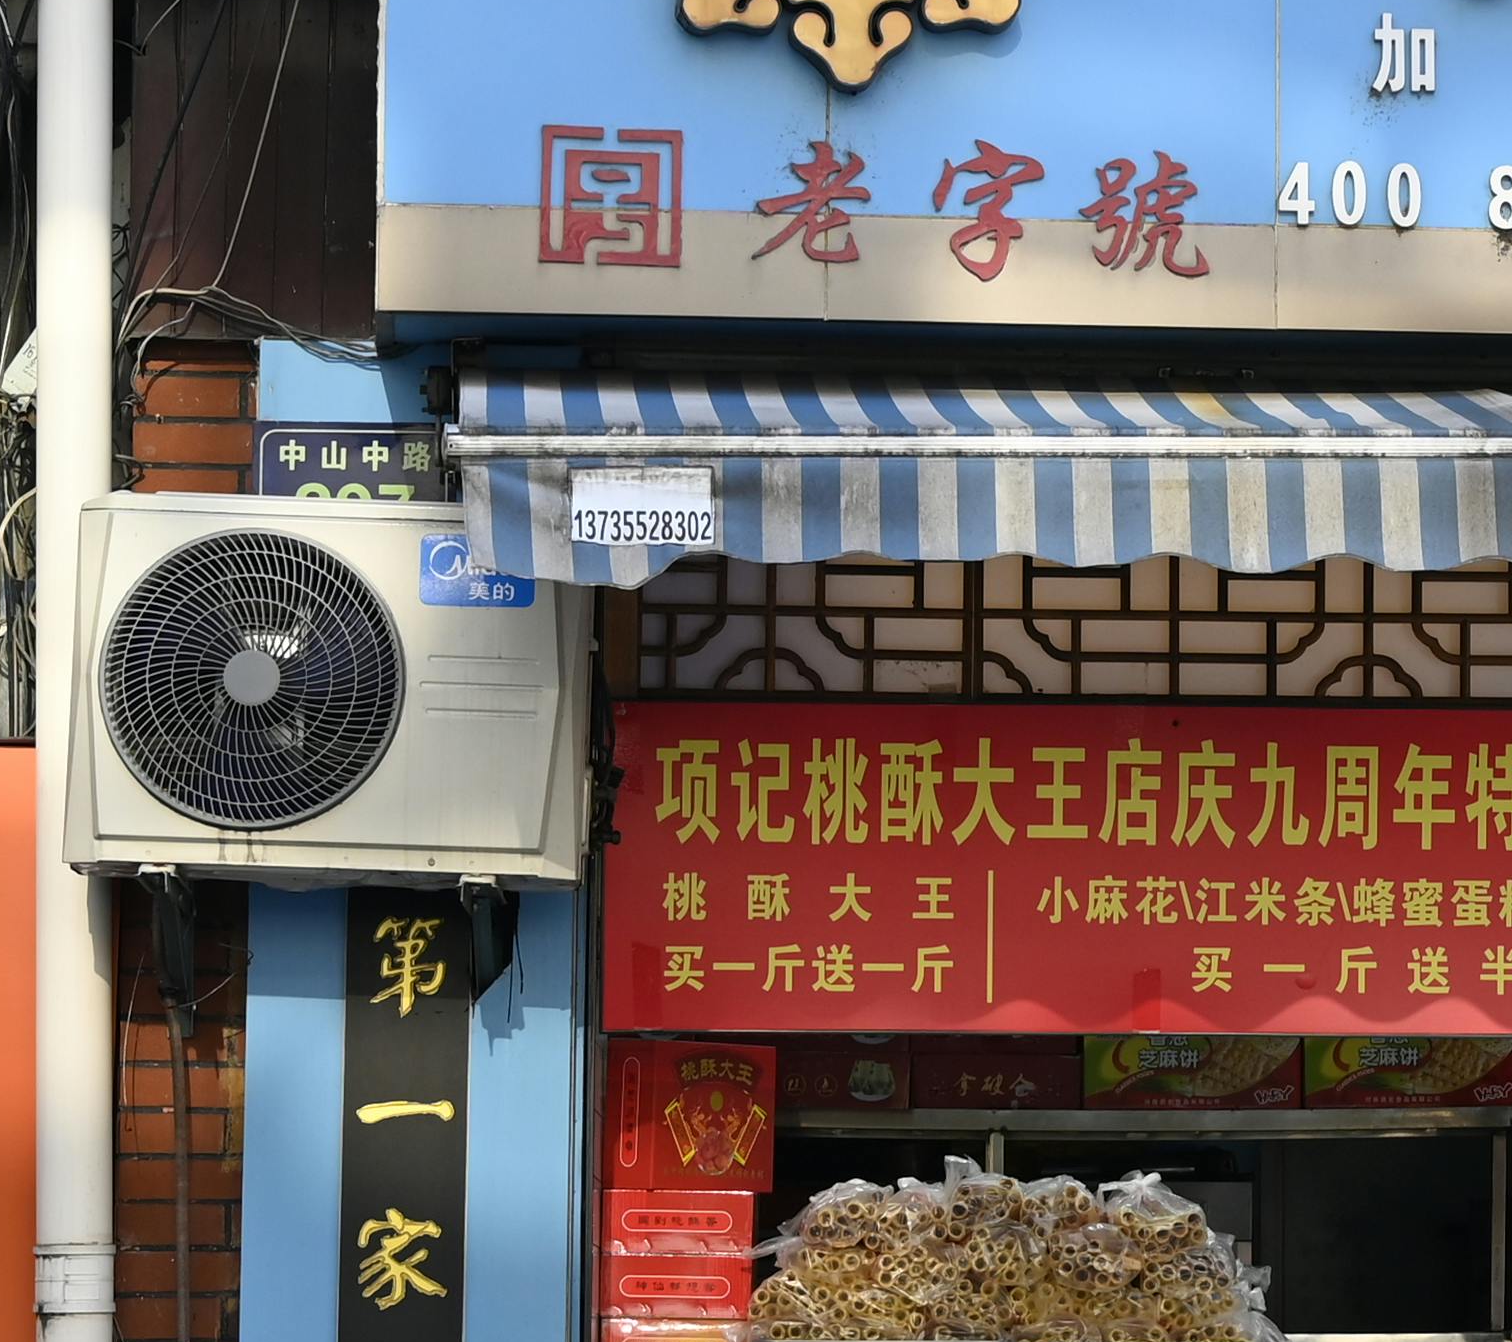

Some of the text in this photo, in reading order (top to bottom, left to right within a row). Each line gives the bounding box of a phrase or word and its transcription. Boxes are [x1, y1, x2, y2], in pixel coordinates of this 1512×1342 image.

[1276, 159, 1422, 229] 400
[278, 439, 431, 474] 中山中路
[572, 508, 713, 544] 13735528302
[468, 581, 516, 601] 美的
[662, 871, 955, 923] 桃酥大王
[663, 944, 955, 995] 买一斤送一斤
[680, 1056, 756, 1086] 桃酥大王
[1137, 1048, 1200, 1070] 芝麻饼
[1359, 1047, 1420, 1069] 芝麻饼
[354, 914, 456, 1312] 第一家
